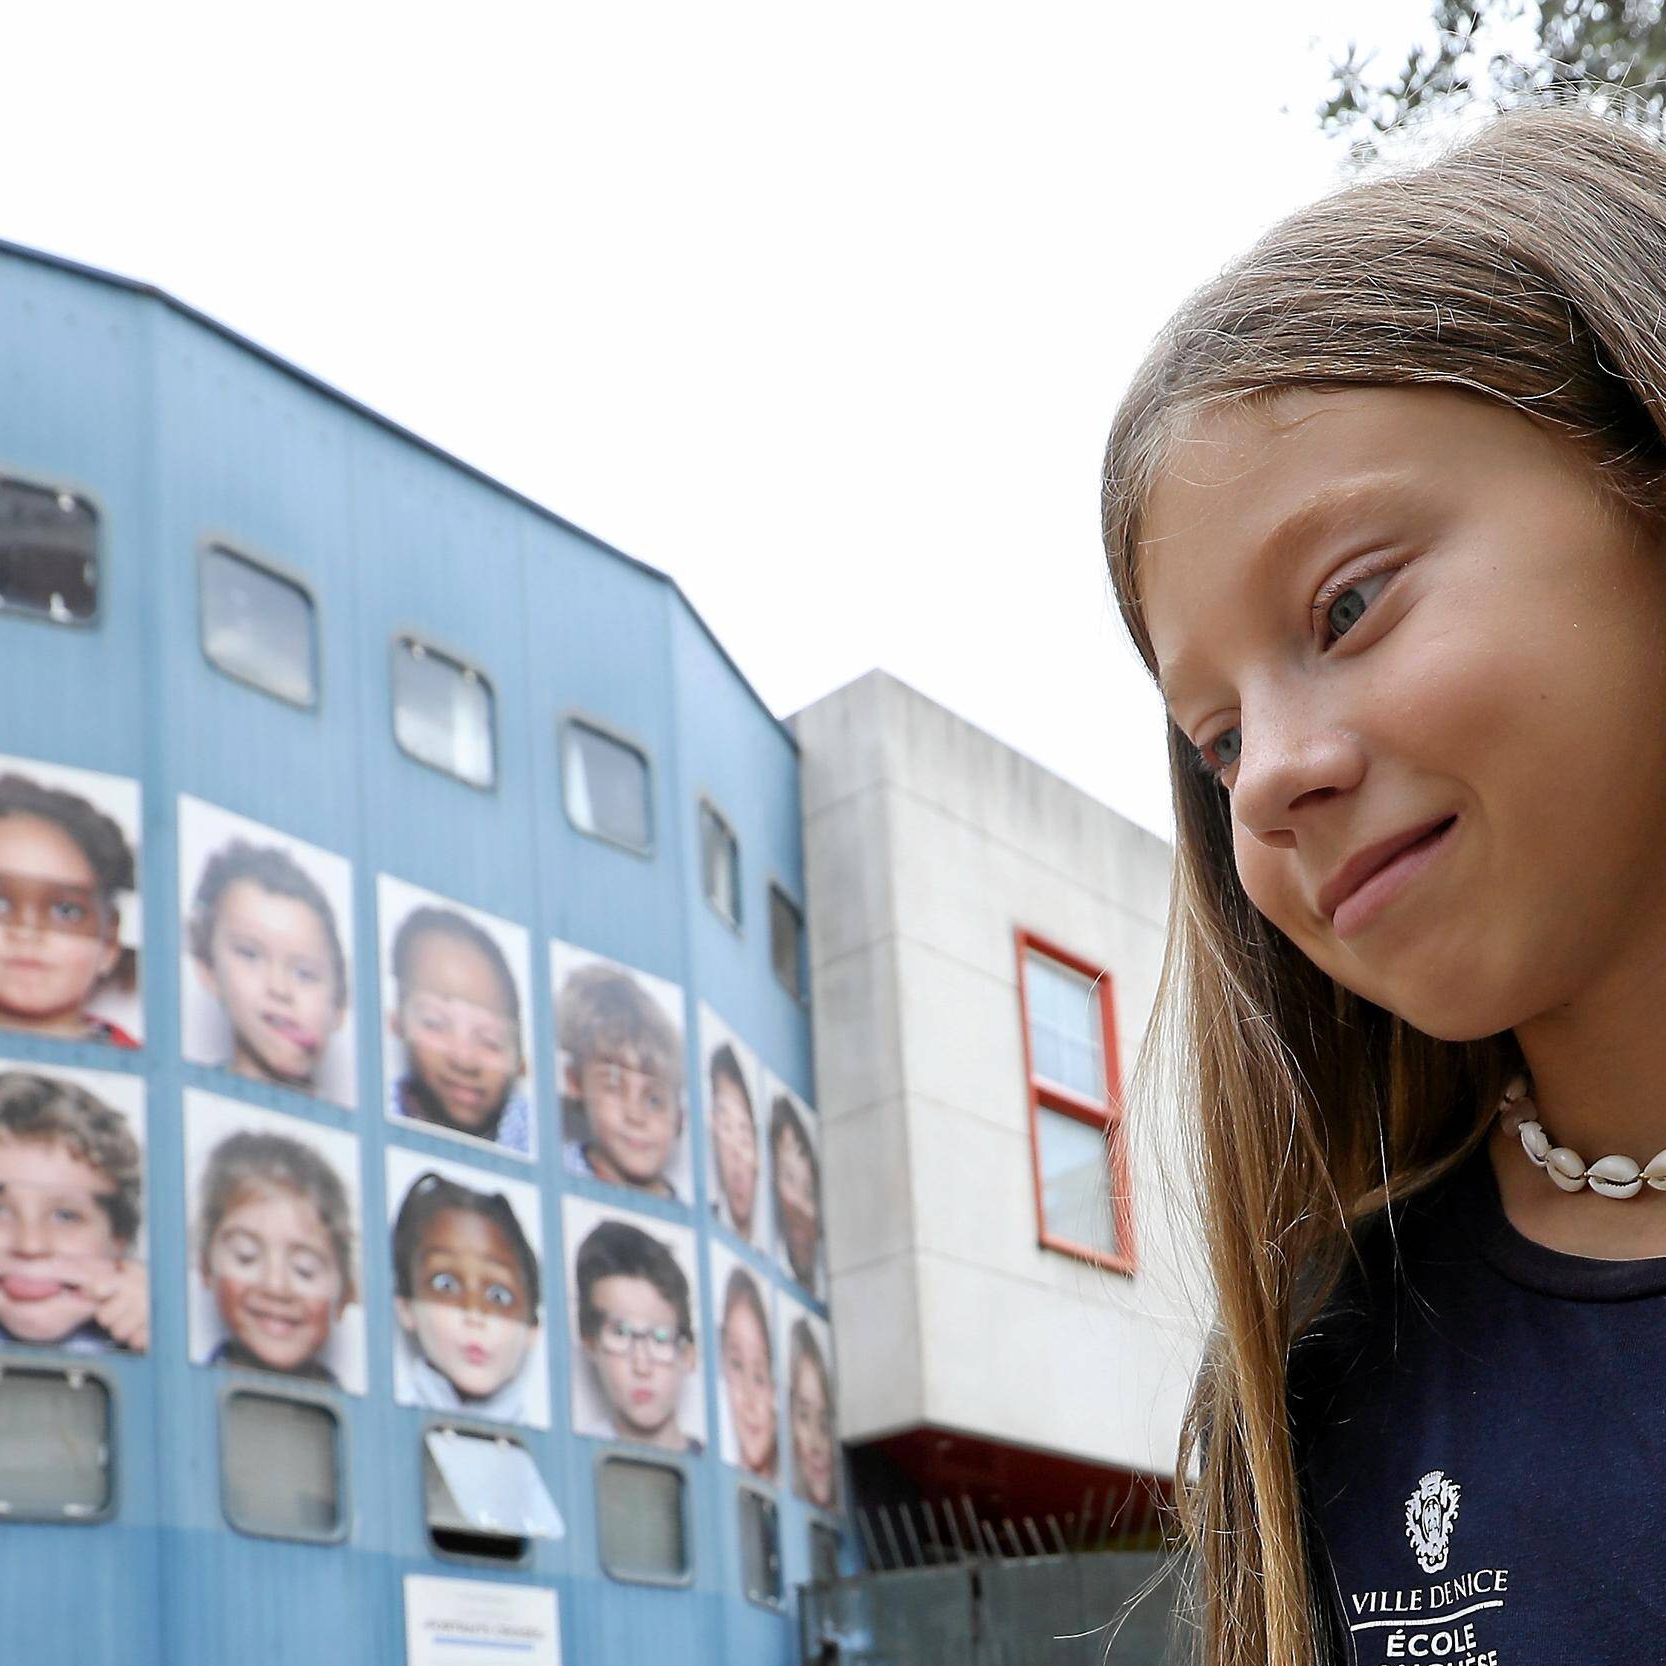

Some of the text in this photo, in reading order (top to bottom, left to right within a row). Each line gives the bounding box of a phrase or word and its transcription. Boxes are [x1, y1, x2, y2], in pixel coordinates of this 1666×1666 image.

[1351, 1569, 1509, 1615] VILLE DE NICE
[1386, 1622, 1477, 1658] ÉCOLE
